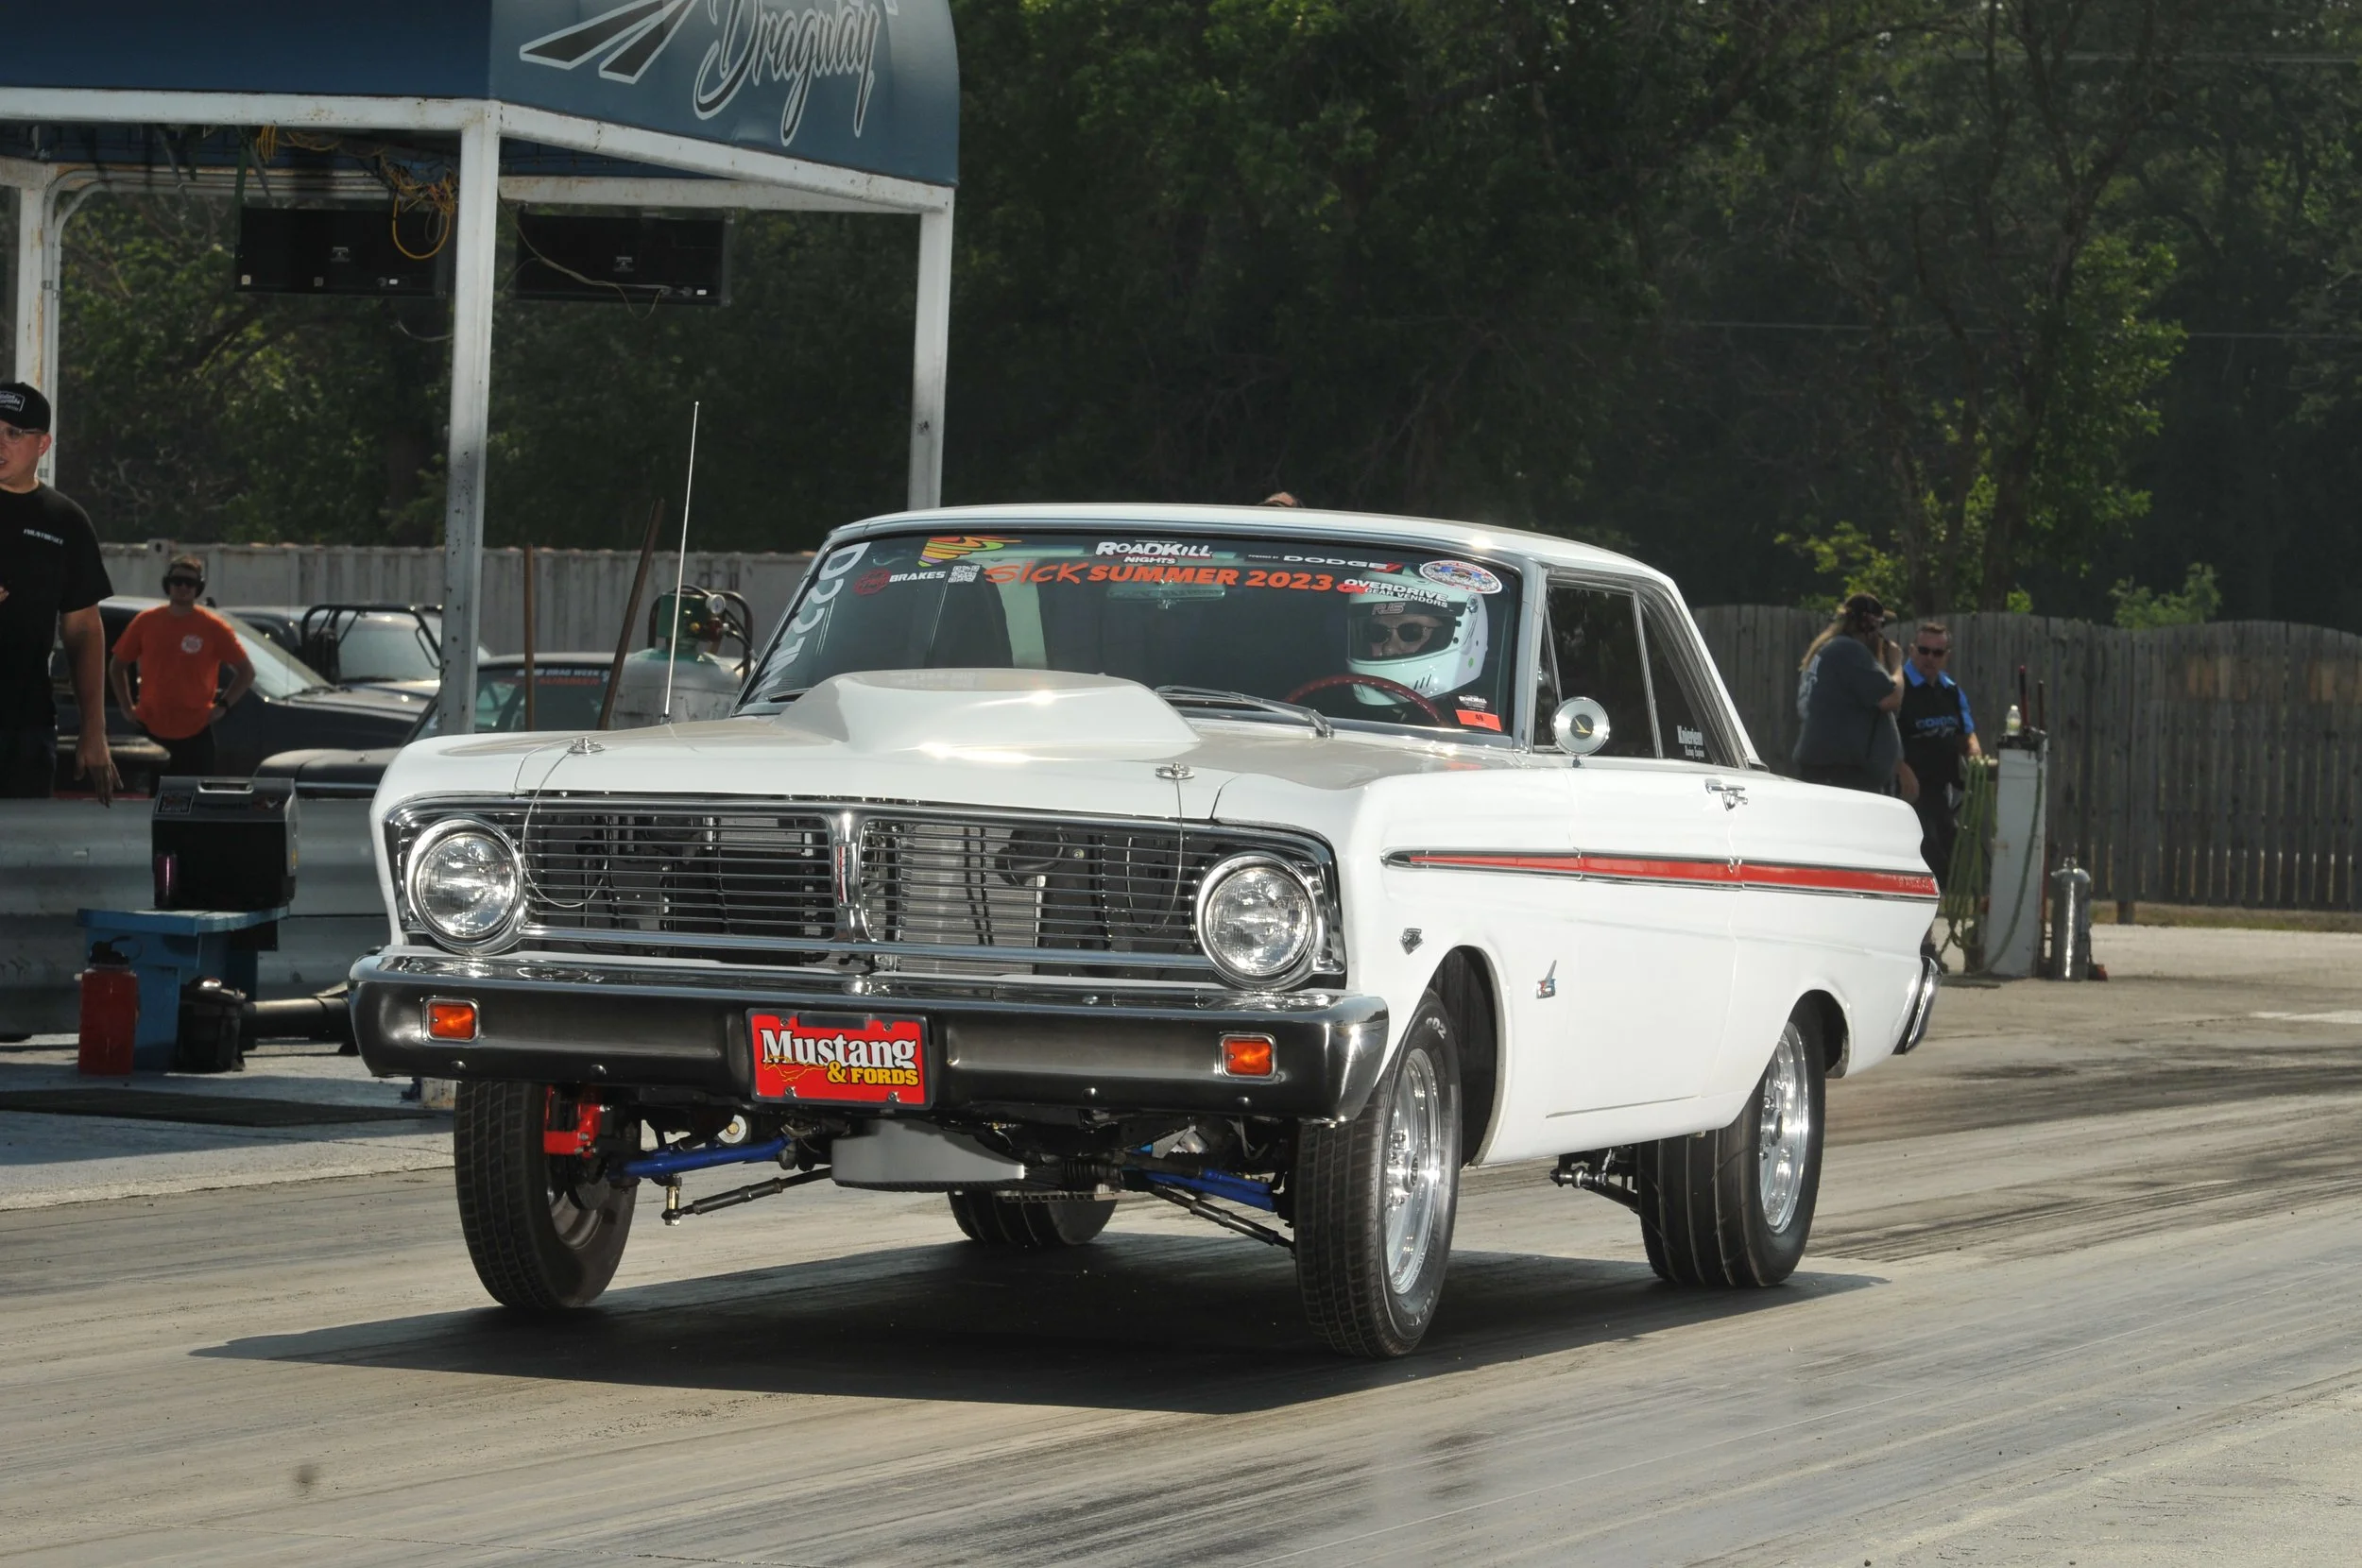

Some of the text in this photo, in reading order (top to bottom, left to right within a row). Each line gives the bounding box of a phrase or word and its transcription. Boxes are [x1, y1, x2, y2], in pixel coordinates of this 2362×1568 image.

[1123, 555, 1177, 565] NIGHTS
[1283, 555, 1387, 570] DODGE
[889, 571, 946, 583] BRAKES
[1087, 565, 1239, 587] SUMMER
[1244, 570, 1334, 591] 2023
[1344, 578, 1449, 602] OVERDRIVE
[1365, 588, 1448, 608] GEAR VENDORS
[760, 1029, 917, 1069] Mustang
[827, 1060, 920, 1086] & FORDS
